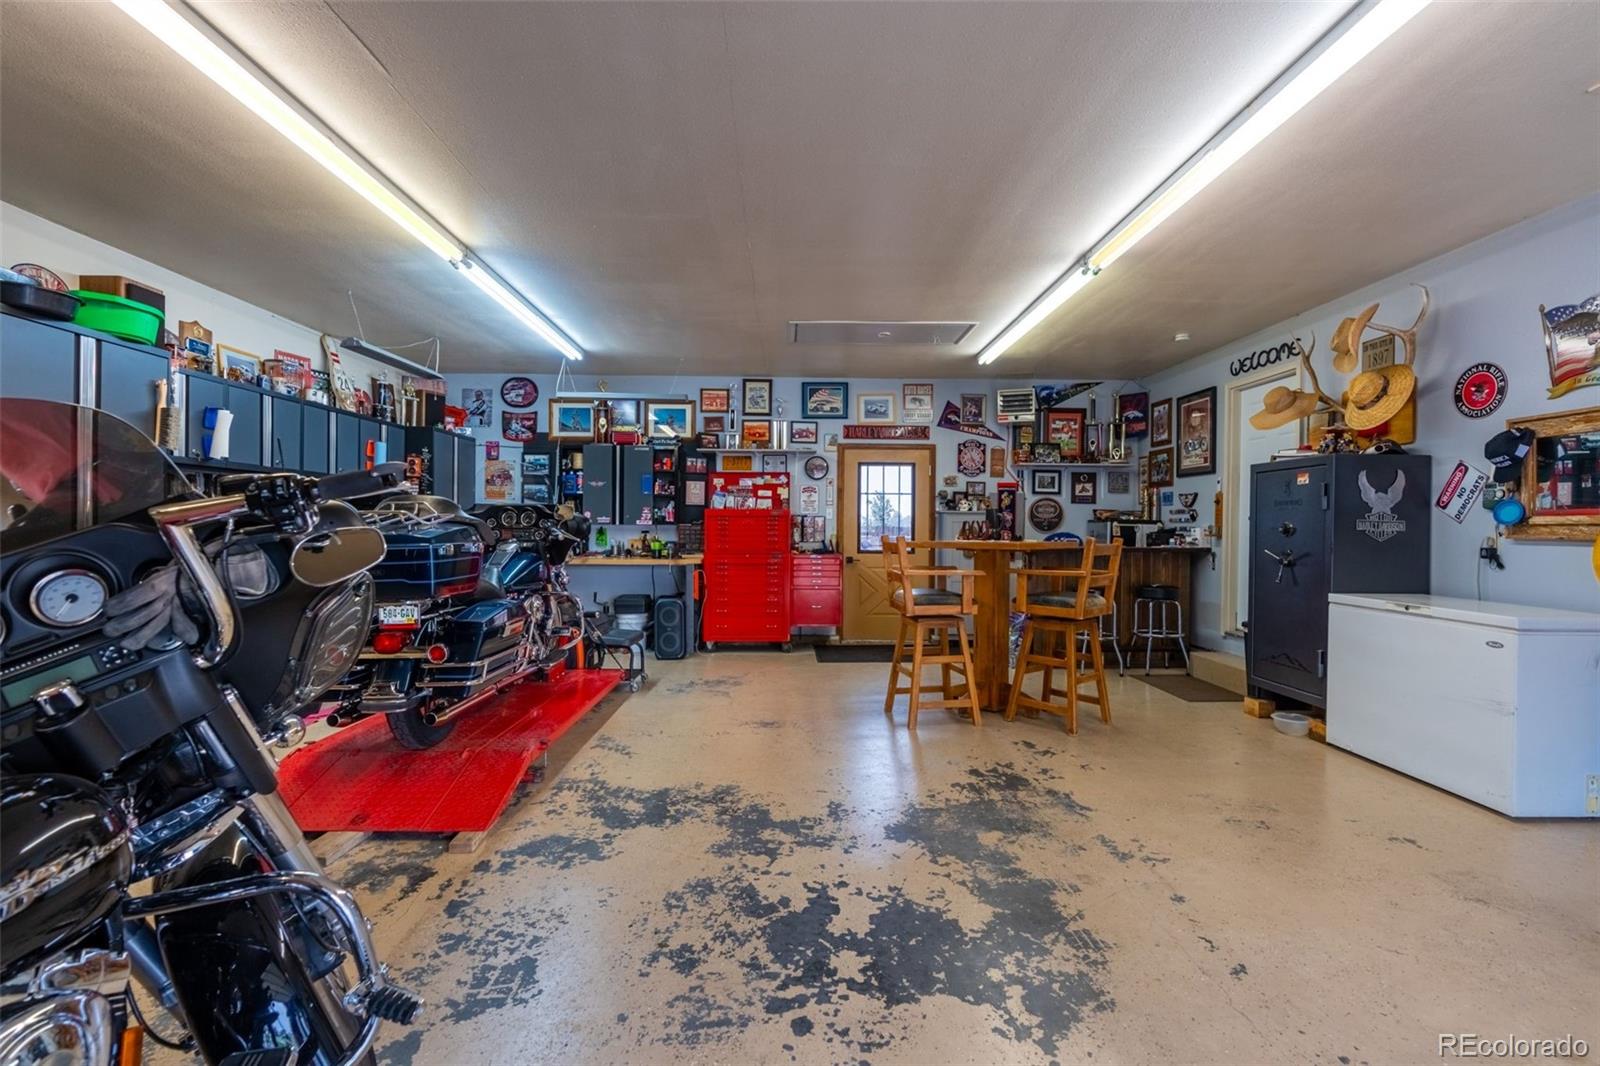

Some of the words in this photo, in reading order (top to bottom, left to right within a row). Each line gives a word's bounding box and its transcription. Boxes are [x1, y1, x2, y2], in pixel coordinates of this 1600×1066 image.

[1230, 338, 1302, 376] WELCOME
[1367, 348, 1389, 369] 1897
[1455, 364, 1488, 396] NATIONAL
[1489, 366, 1506, 387] RIFLE
[1456, 394, 1502, 417] ASSOCIATION
[1442, 472, 1462, 503] WARNING
[1454, 475, 1485, 520] DEMOCRATS
[1457, 487, 1467, 499] NO
